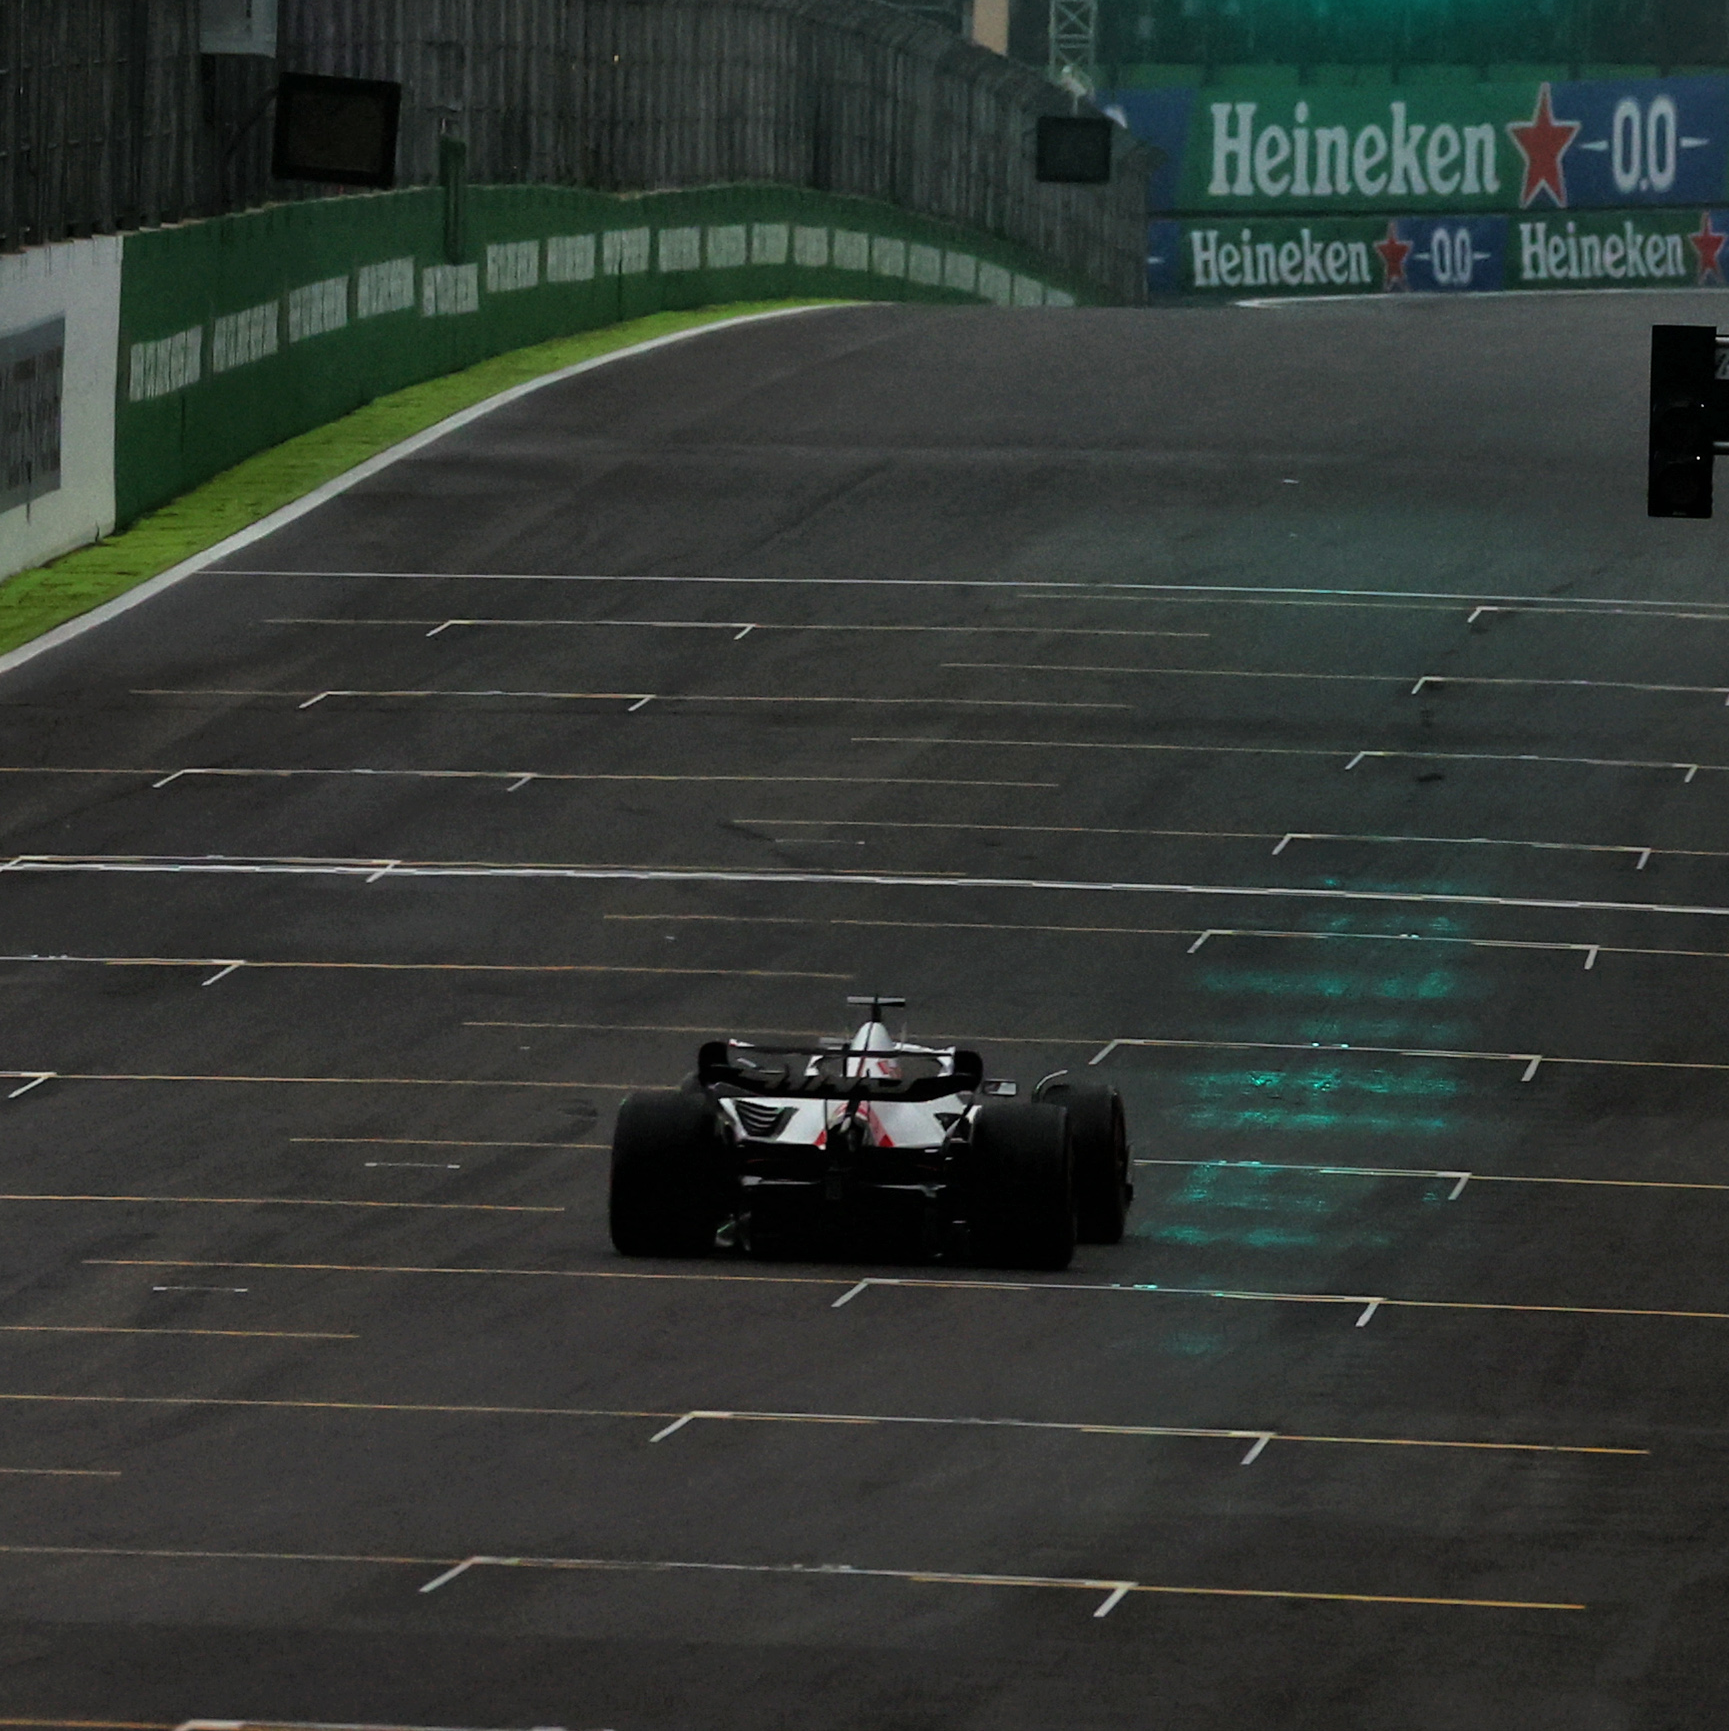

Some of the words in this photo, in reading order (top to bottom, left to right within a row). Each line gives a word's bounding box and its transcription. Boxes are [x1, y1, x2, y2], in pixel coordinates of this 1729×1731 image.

[1207, 101, 1501, 197] Heineken
[1610, 95, 1678, 193] 0.0
[1190, 227, 1372, 288] Heineken
[1519, 219, 1687, 281] Heineken
